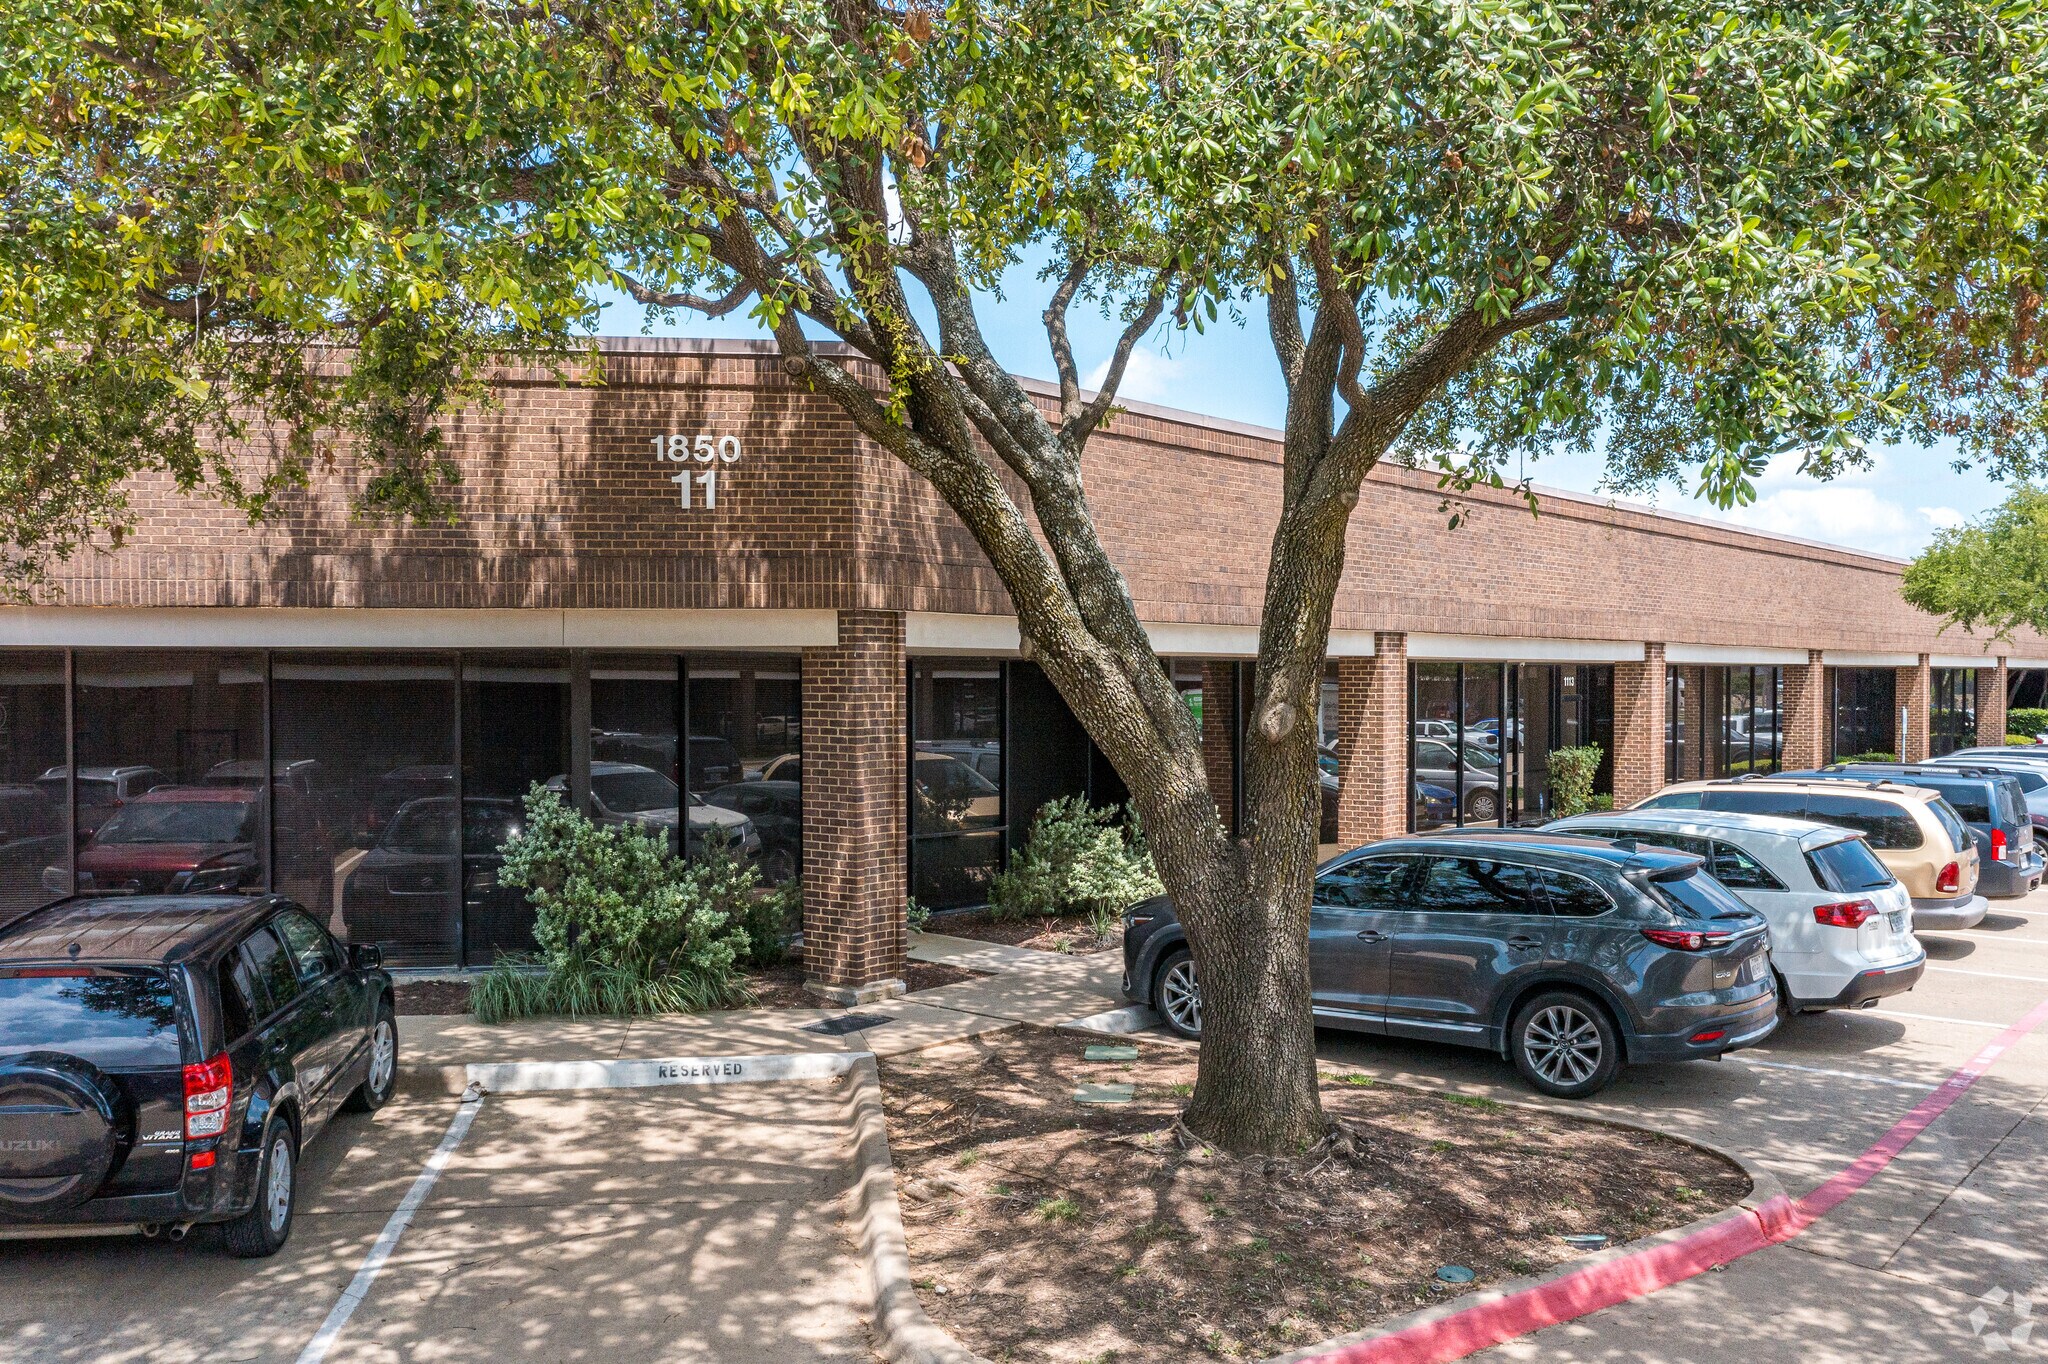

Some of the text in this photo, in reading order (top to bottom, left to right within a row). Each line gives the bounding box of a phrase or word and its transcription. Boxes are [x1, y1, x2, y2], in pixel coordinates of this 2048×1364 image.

[650, 434, 742, 463] 1850
[671, 469, 716, 510] 11
[1563, 676, 1575, 687] 1113
[658, 1063, 742, 1079] RESERVED
[0, 1139, 62, 1151] UZUKI
